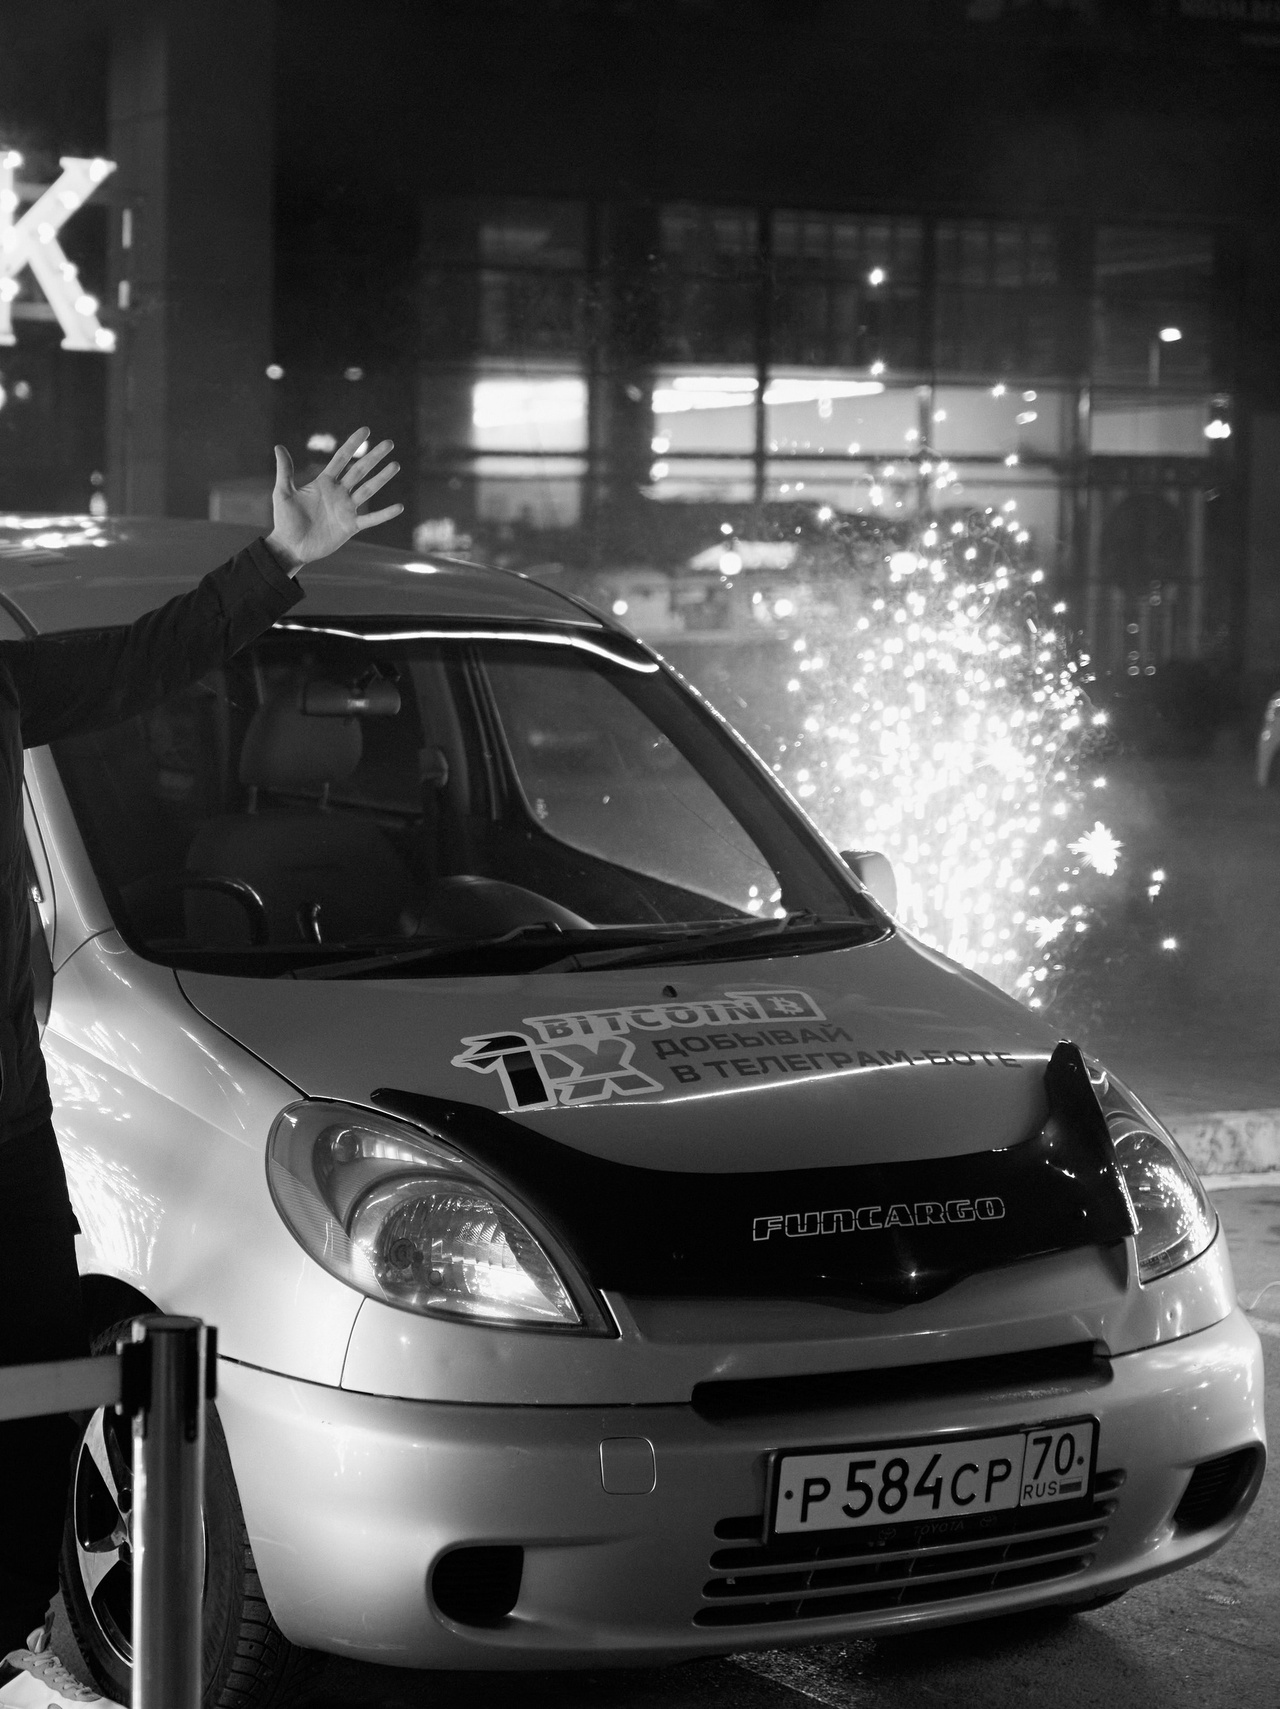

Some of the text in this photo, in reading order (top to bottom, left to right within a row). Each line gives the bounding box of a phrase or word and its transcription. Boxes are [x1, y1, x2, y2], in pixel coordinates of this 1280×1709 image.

[651, 1023, 854, 1061] ДОБЫВАЙ
[670, 1049, 1024, 1085] В ТЕЛЕГРАМ-БОТЕ
[752, 1196, 1006, 1242] FUNCARGO
[1031, 1432, 1077, 1481] 70
[1022, 1480, 1058, 1500] RUS
[913, 1519, 965, 1536] TOYOTA
